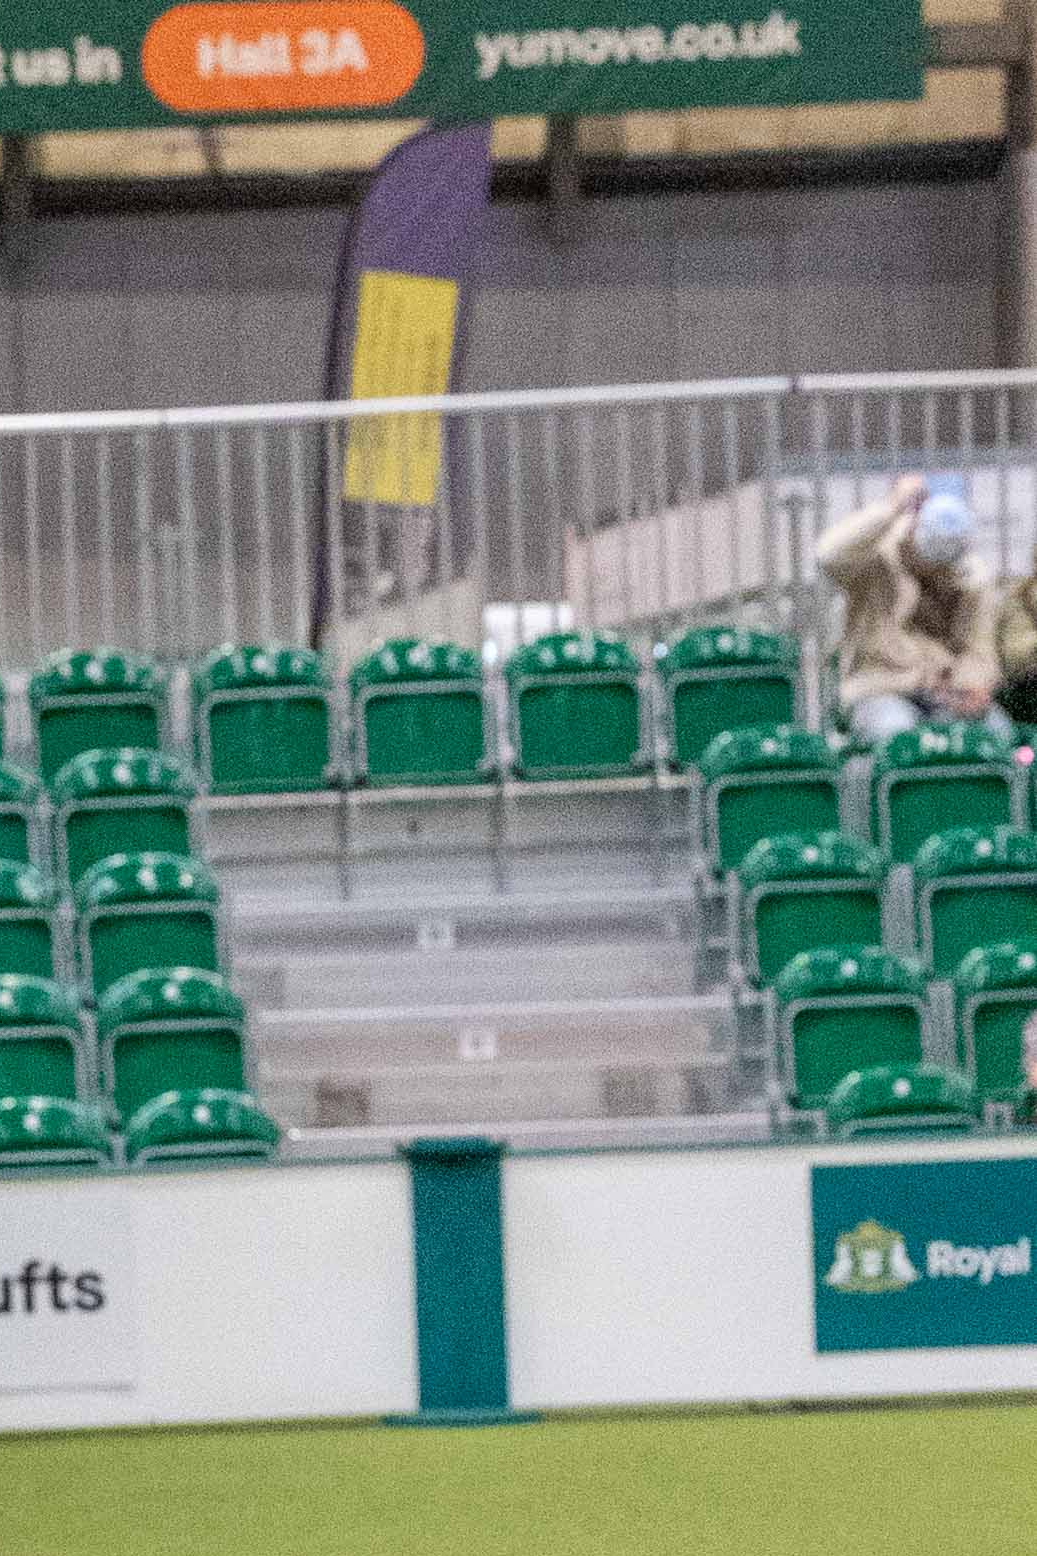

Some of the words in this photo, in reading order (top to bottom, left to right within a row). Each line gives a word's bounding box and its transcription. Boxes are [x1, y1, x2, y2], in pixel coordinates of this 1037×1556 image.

[12, 46, 70, 86] us
[74, 35, 121, 84] in
[196, 32, 291, 79] Hall
[300, 28, 367, 76] 3A
[474, 10, 801, 80] yumove.co.uk
[926, 1236, 1031, 1285] Royal
